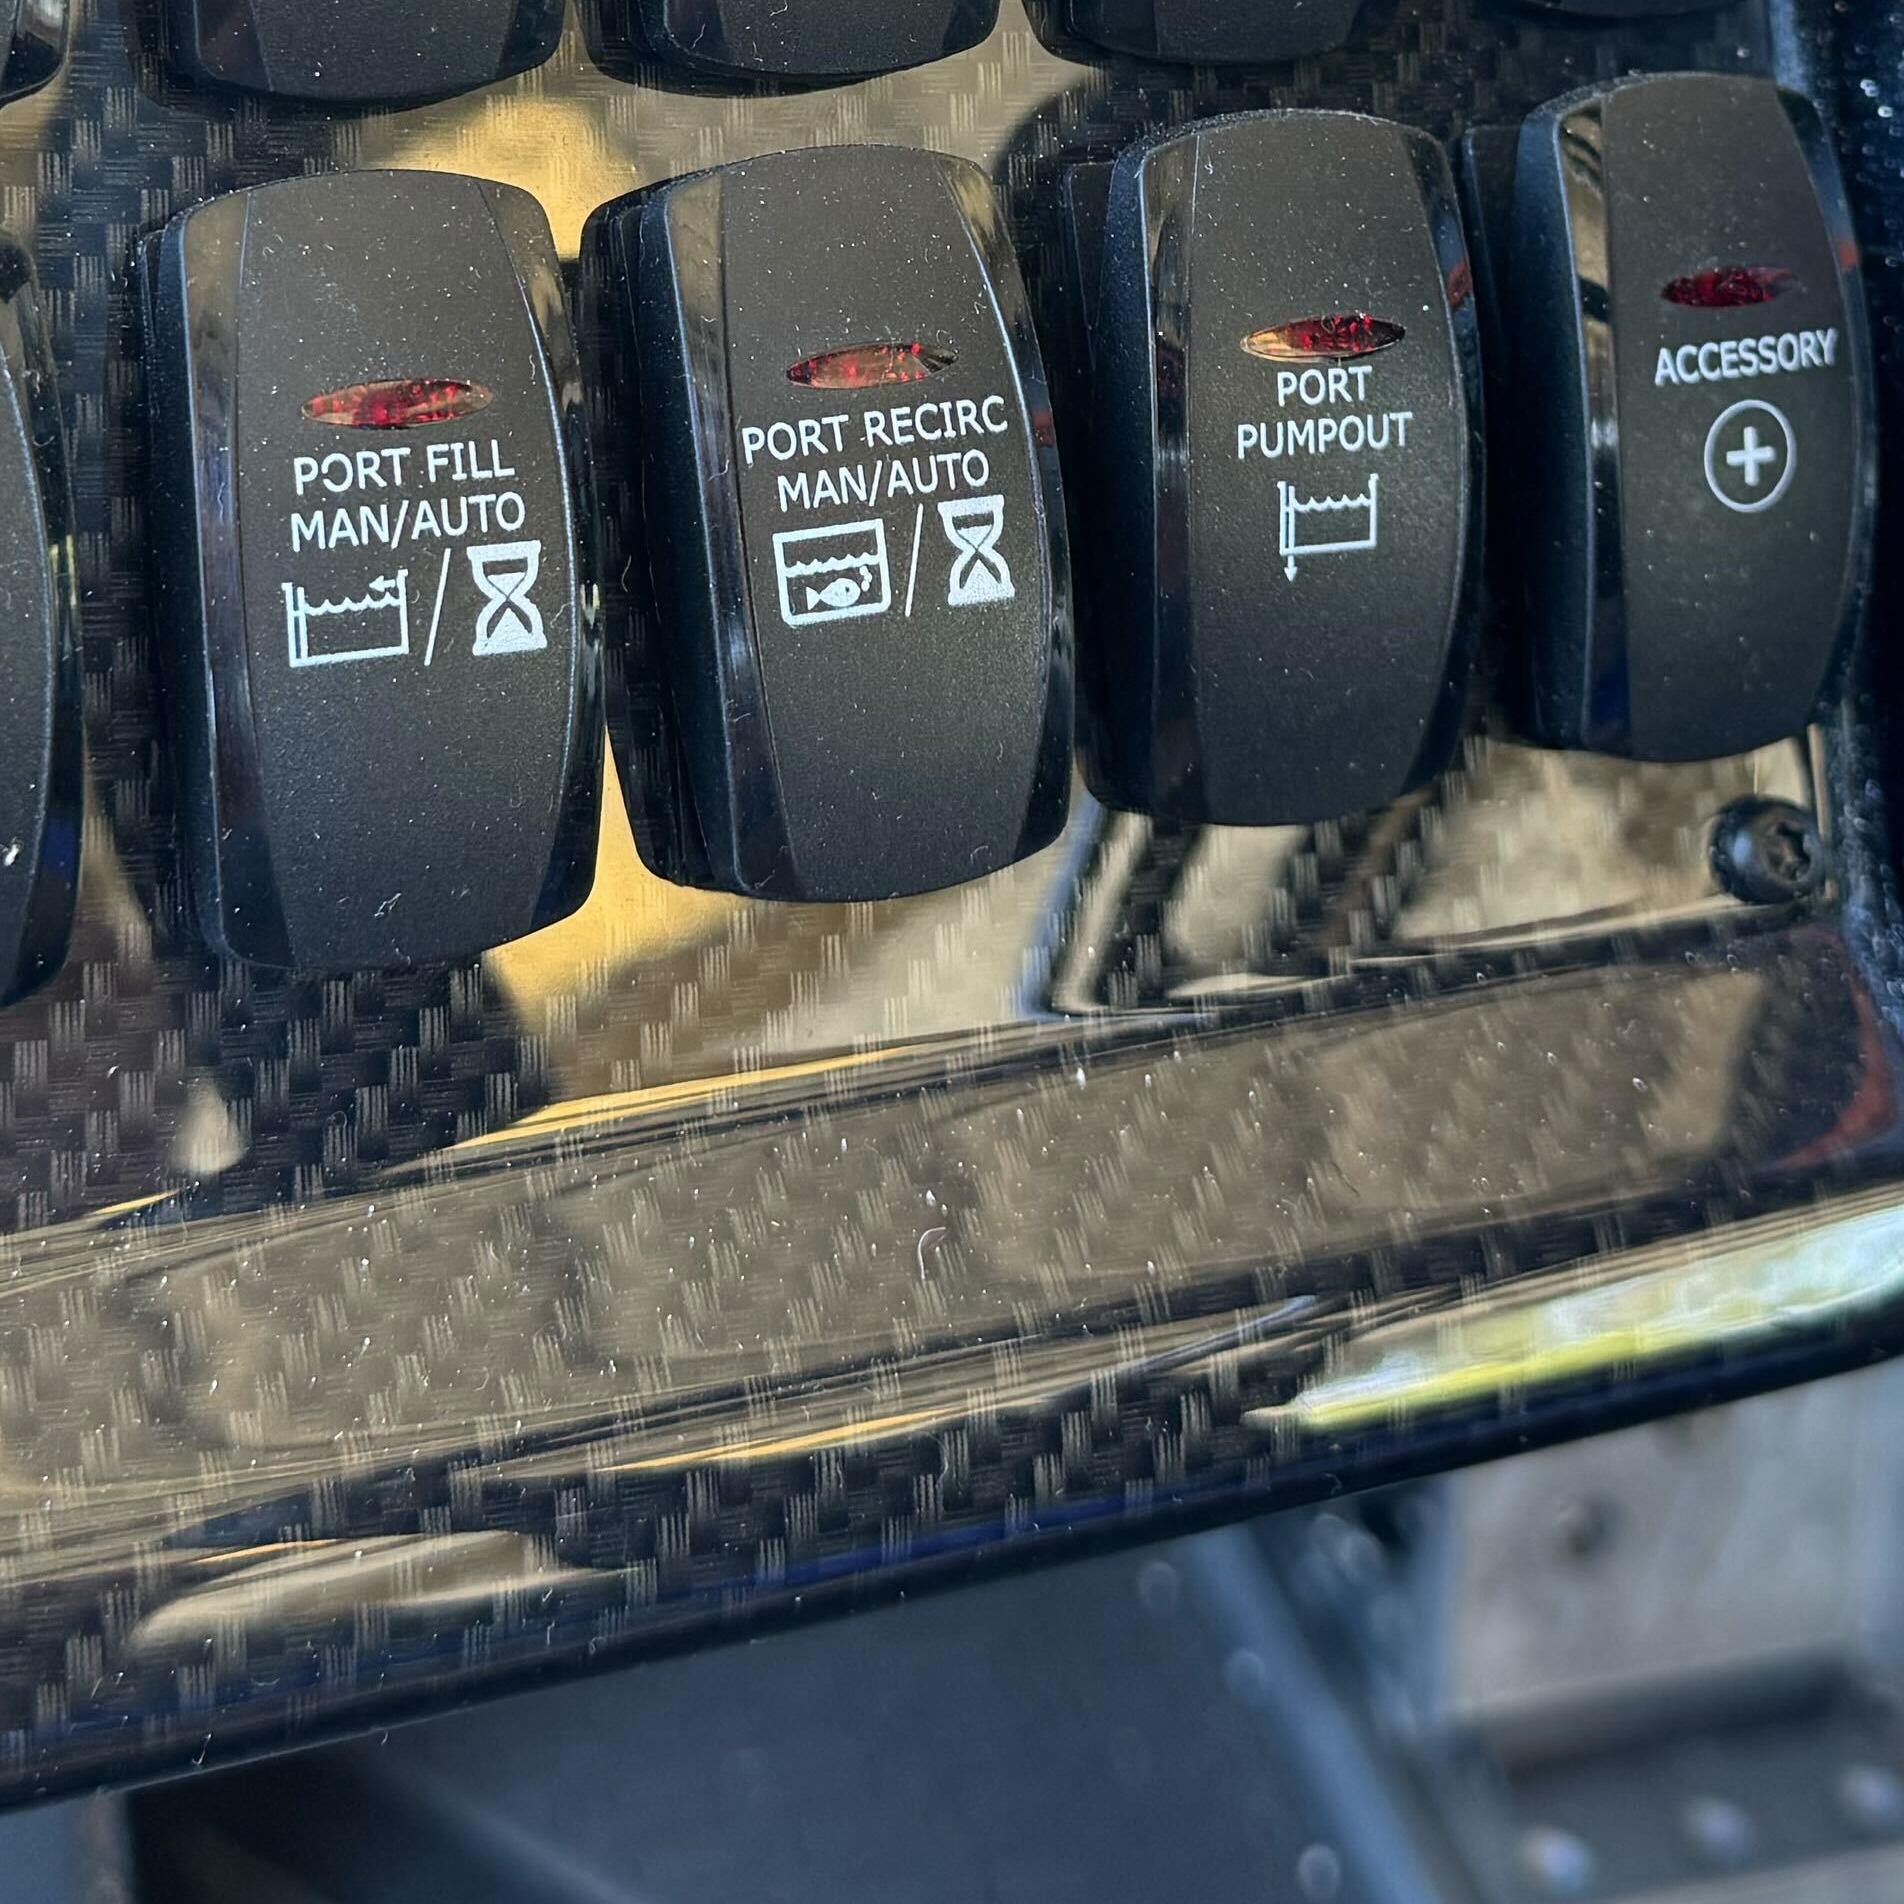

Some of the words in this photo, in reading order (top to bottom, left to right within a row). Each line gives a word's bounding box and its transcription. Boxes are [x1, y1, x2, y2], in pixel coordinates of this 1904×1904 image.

[1277, 365, 1372, 407] PORT
[1655, 327, 1839, 386] ACCESSORY
[742, 415, 849, 464] PORT
[864, 395, 1008, 447] RECIRC
[1238, 412, 1413, 460] PUMPOUT
[294, 447, 411, 495] PORT
[426, 439, 515, 482] FILL
[778, 449, 989, 512] MAN/AUTO
[291, 491, 525, 552] MAN/AUTO
